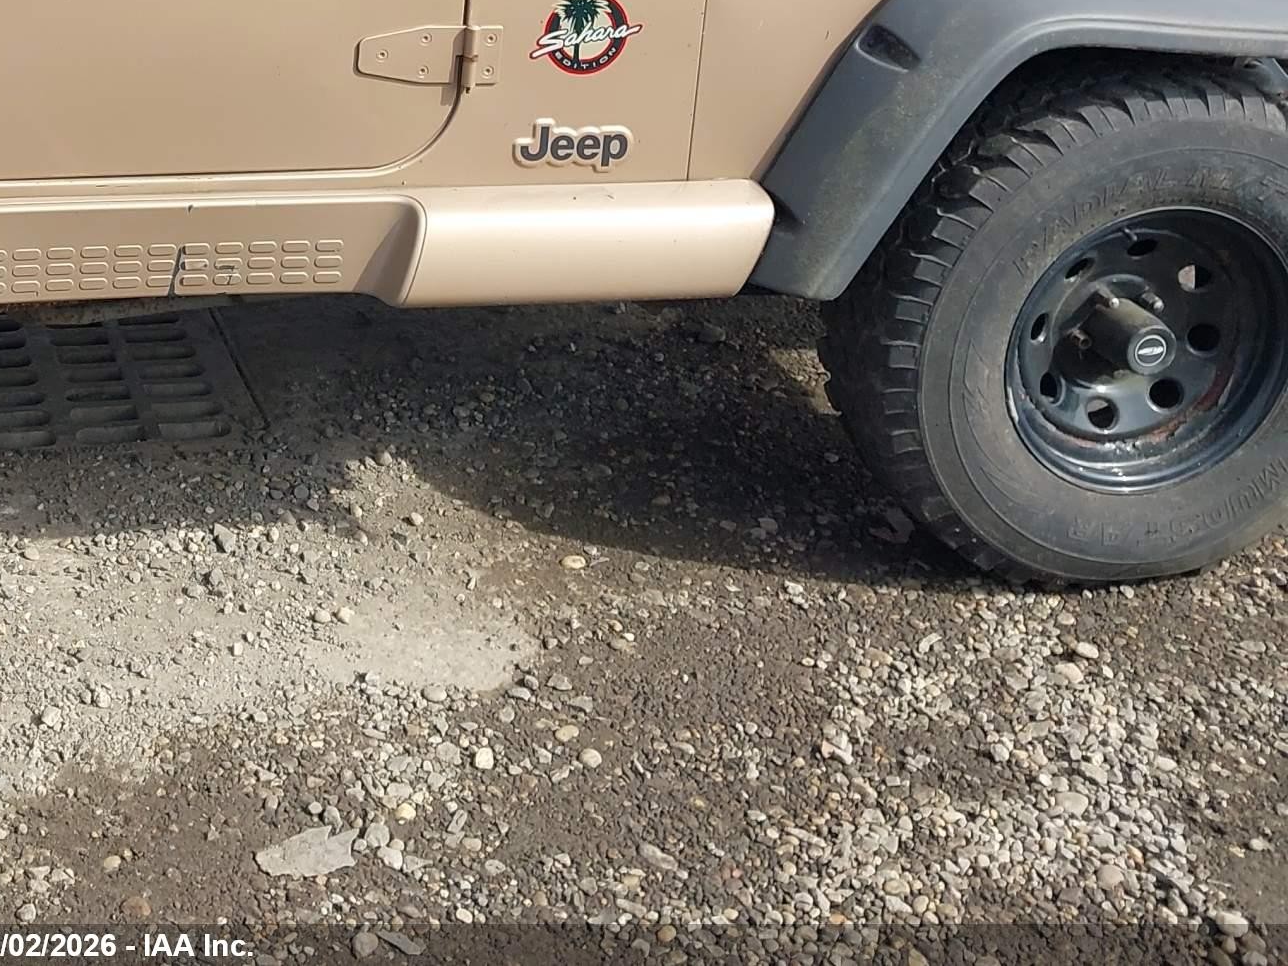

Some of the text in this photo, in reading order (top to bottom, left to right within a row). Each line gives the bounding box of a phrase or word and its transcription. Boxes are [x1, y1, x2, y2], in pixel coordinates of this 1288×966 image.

[529, 22, 643, 60] Sahara
[555, 47, 617, 70] EDITION
[517, 122, 631, 170] Jeep
